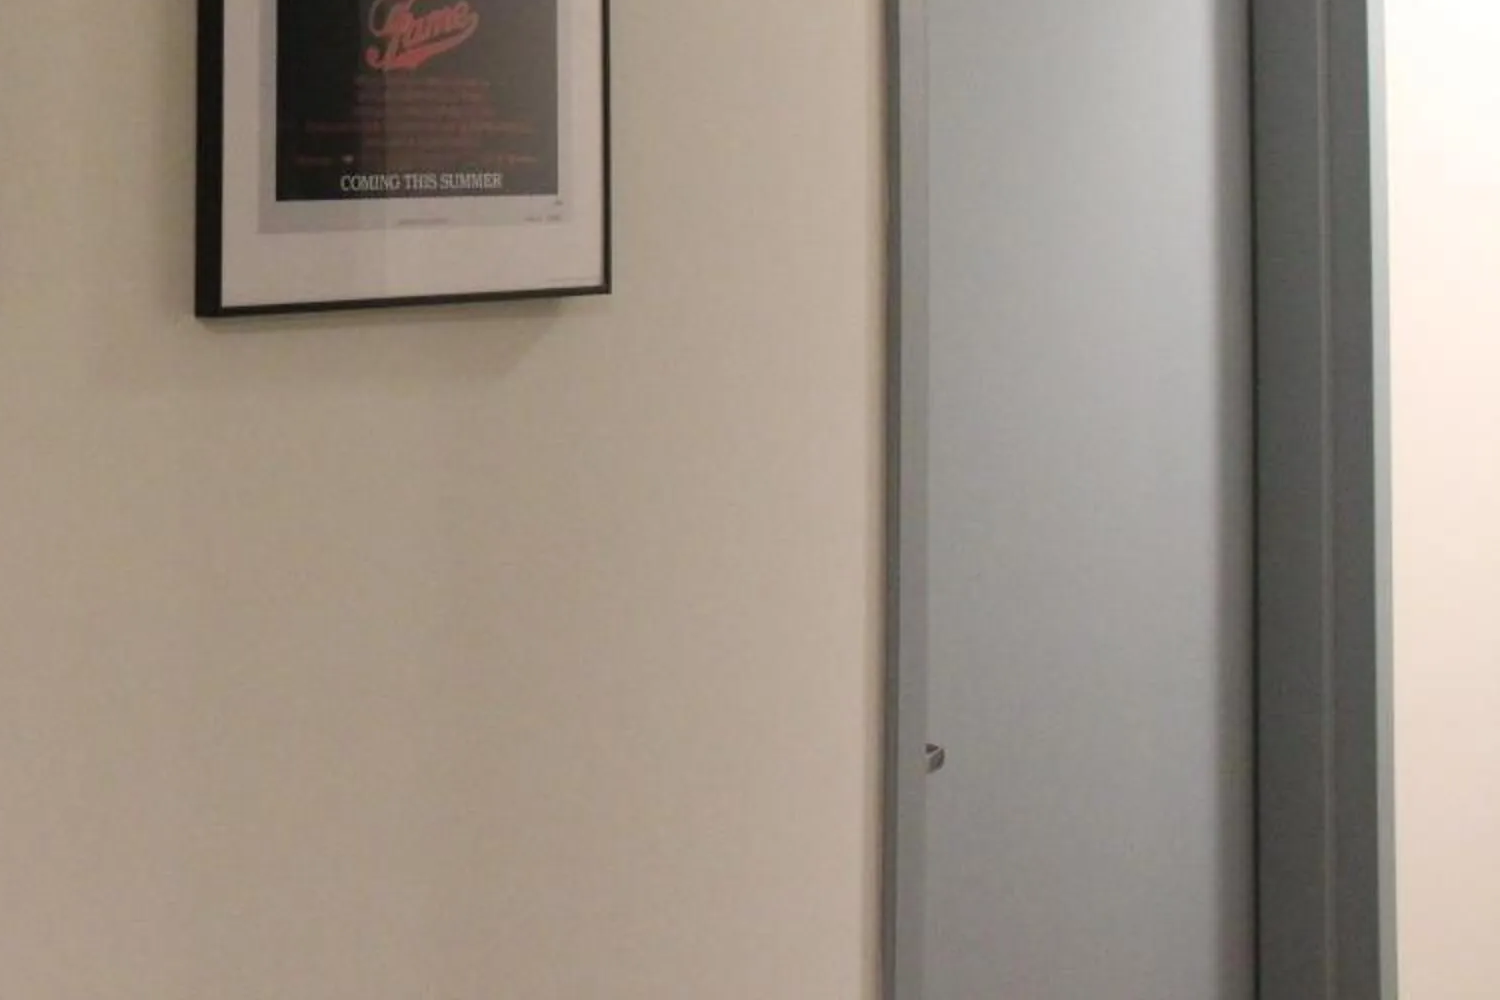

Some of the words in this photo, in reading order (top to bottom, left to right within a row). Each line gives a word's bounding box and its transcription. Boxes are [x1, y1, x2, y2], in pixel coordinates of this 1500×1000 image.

[339, 173, 401, 192] COMING
[402, 171, 438, 190] THIS
[439, 170, 503, 190] SUMMER
